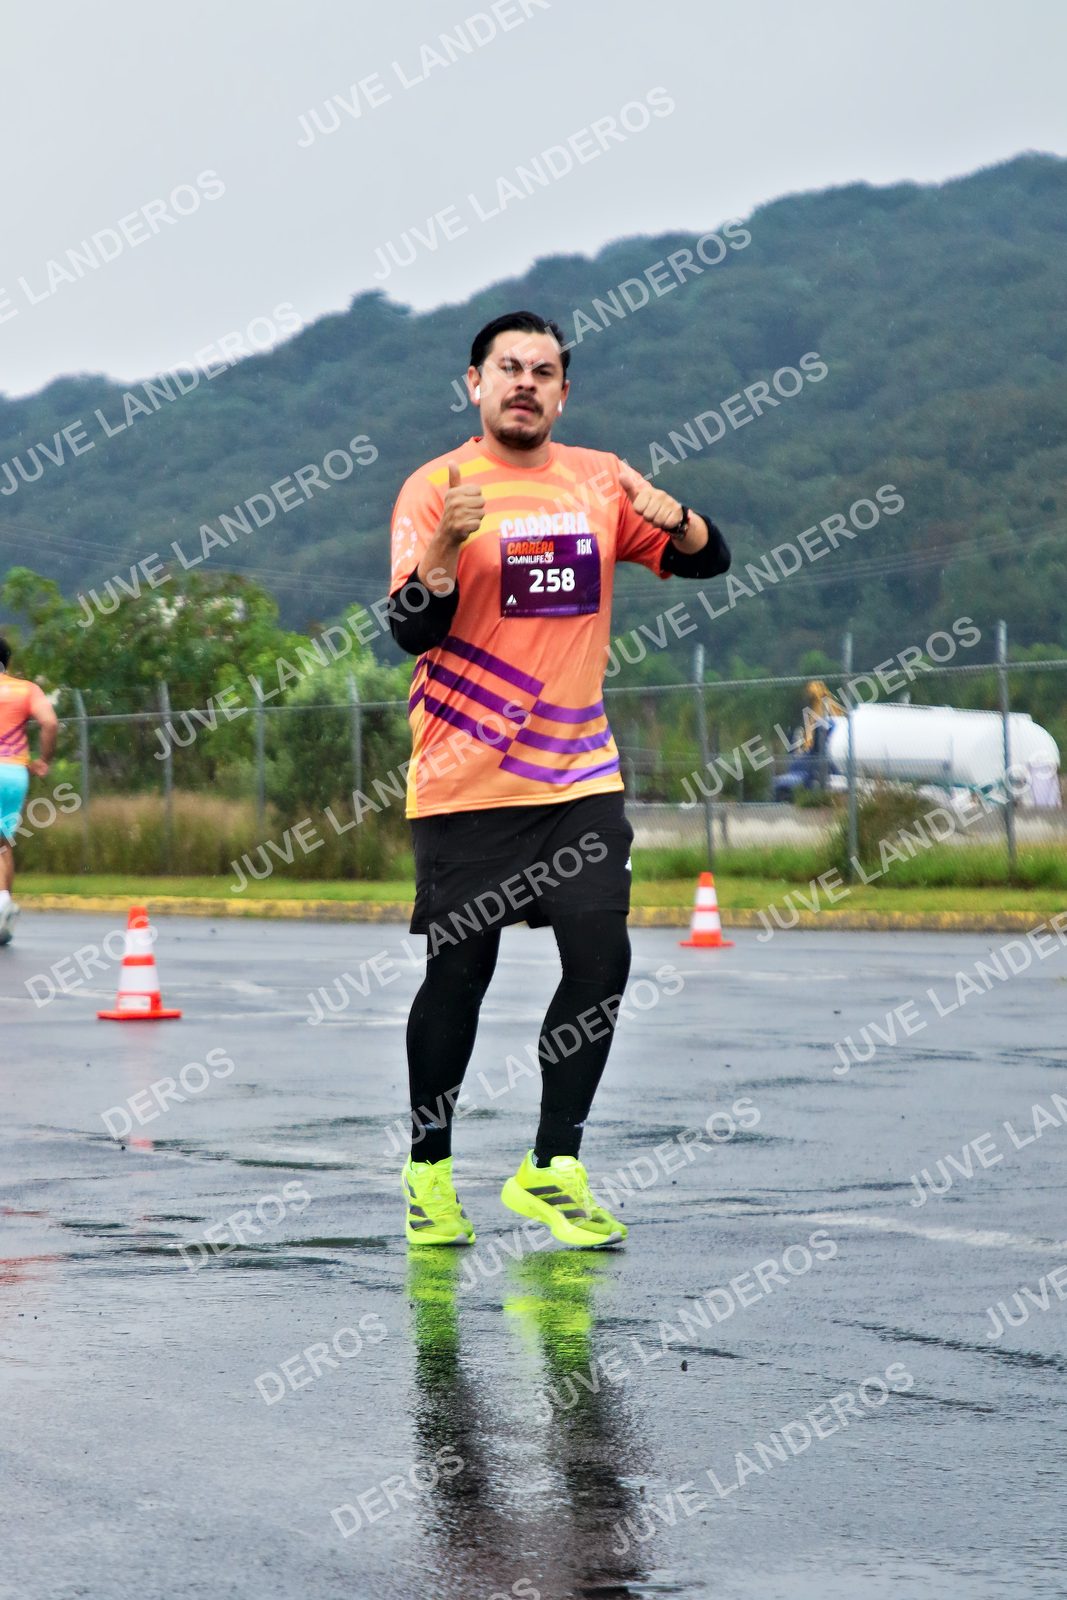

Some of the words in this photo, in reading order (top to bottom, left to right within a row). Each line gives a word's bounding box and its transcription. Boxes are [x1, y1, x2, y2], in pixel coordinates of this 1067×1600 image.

[507, 541, 554, 555] CARRERA
[507, 554, 544, 565] OMNILIFE
[529, 567, 576, 593] 258
